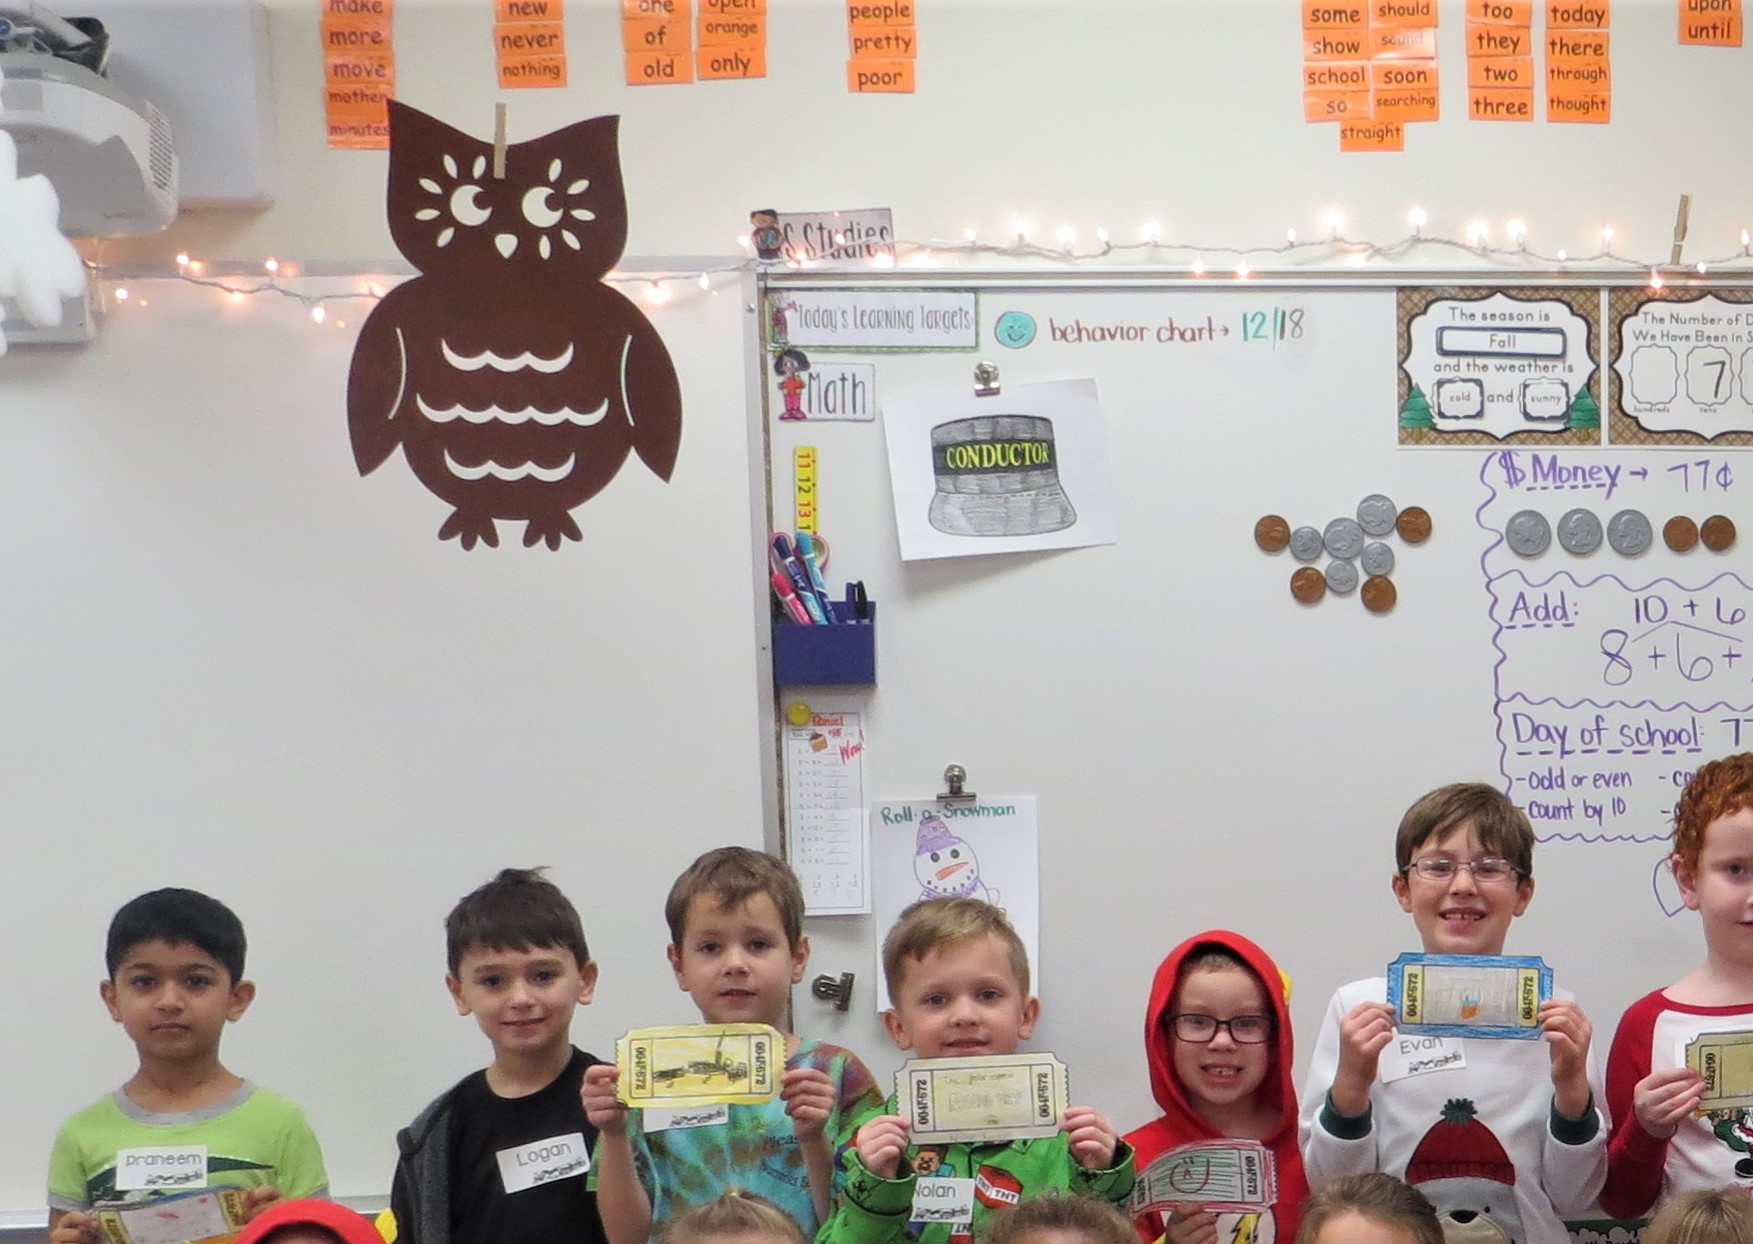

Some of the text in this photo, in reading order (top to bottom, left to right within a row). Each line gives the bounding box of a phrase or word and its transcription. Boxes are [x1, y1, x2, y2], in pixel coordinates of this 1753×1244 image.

[329, 0, 383, 14] make
[508, 1, 547, 16] new
[849, 2, 911, 23] people
[1310, 7, 1361, 24] some
[1378, 1, 1430, 17] should
[1481, 3, 1514, 19] too
[1550, 5, 1605, 27] today
[329, 30, 383, 45] more
[645, 25, 666, 45] of
[705, 21, 758, 37] orange
[1688, 22, 1732, 40] until
[501, 32, 559, 48] never
[853, 33, 912, 53] pretty
[1312, 37, 1360, 54] show
[1476, 32, 1520, 54] they
[1549, 39, 1604, 57] there
[333, 61, 385, 77] move
[503, 63, 560, 80] nothing
[643, 59, 674, 78] old
[710, 52, 751, 76] only
[1483, 64, 1518, 82] two
[857, 69, 902, 91] poor
[1307, 67, 1365, 85] school
[1383, 68, 1428, 84] soon
[1549, 65, 1607, 84] through
[1325, 99, 1347, 115] so
[1376, 92, 1436, 110] searching
[1474, 97, 1529, 115] three
[1549, 95, 1606, 114] thought
[1340, 124, 1401, 142] straight
[853, 306, 914, 331] Learning
[921, 305, 972, 331] Targets
[1448, 307, 1550, 322] The season is
[1641, 311, 1666, 326] The
[1669, 312, 1722, 327] Number
[1726, 313, 1742, 326] of
[1050, 308, 1305, 351] behavior chart 12/18
[1632, 330, 1656, 343] We
[1660, 330, 1692, 343] Have
[1695, 331, 1728, 343] Been
[1488, 333, 1518, 350] Fall
[1433, 359, 1575, 375] and the weather is
[1703, 358, 1727, 400] 7
[807, 372, 867, 415] Math
[1486, 389, 1514, 403] and
[945, 442, 1051, 471] CONDUCTOR
[1531, 454, 1620, 498] Money
[1508, 591, 1580, 624] Add:
[1633, 594, 1746, 626] 10 6
[1512, 711, 1568, 757] Day
[1580, 715, 1605, 745] of
[1571, 772, 1633, 788] or even
[1583, 796, 1628, 827] by 10
[515, 1142, 572, 1167] Logan
[994, 1189, 1017, 1203] TNT
